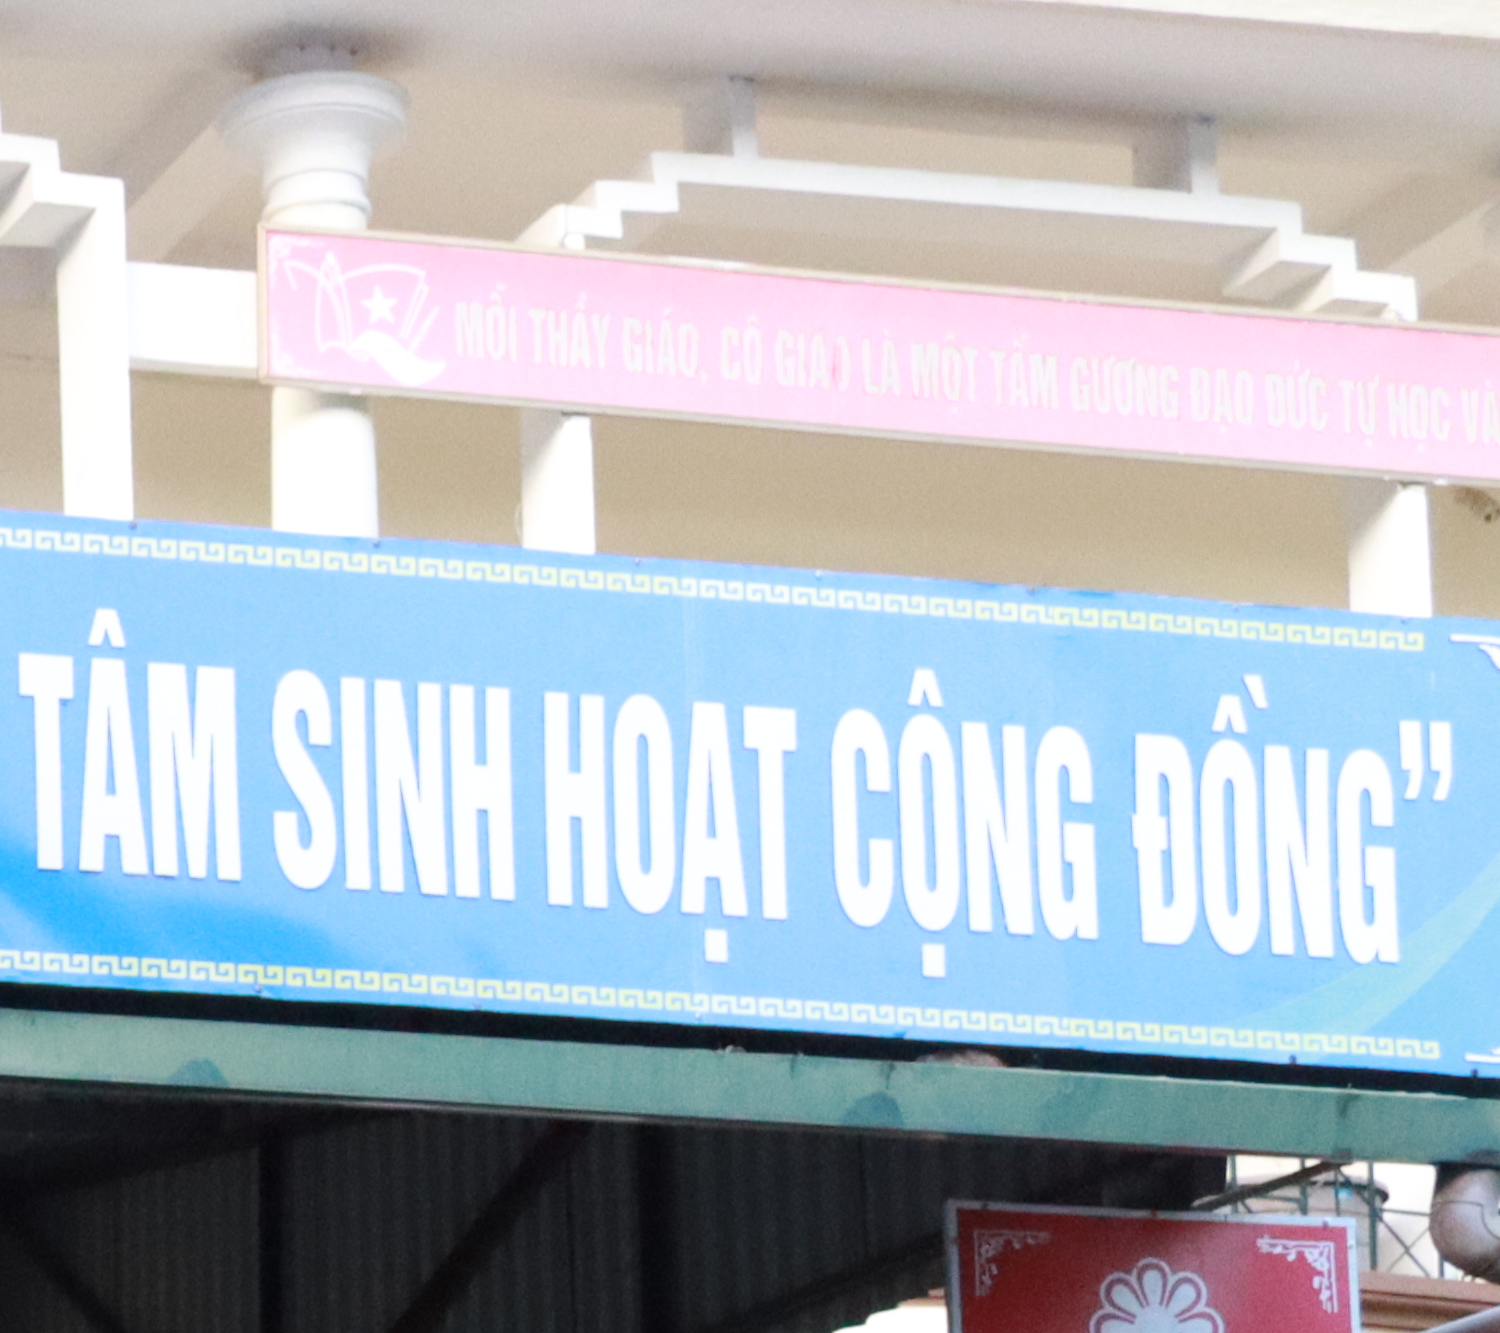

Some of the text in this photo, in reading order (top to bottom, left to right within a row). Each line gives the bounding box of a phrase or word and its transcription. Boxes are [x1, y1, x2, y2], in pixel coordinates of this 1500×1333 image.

[528, 291, 609, 369] THẦY
[720, 315, 762, 385] CÔ
[861, 329, 901, 396] LÀ
[910, 332, 976, 414] MỘT
[1069, 355, 1180, 420] GƯƠNG
[1189, 366, 1255, 434] ĐẠO
[1265, 361, 1330, 432] ĐỨC
[1387, 382, 1451, 452] HỌC
[1460, 380, 1500, 446] VÀ
[17, 608, 243, 884] TÂM
[269, 670, 520, 904] SINH
[545, 686, 801, 964] HOẠT
[829, 668, 1102, 978] CỘNG
[1131, 673, 1452, 966] ĐỒNG”
